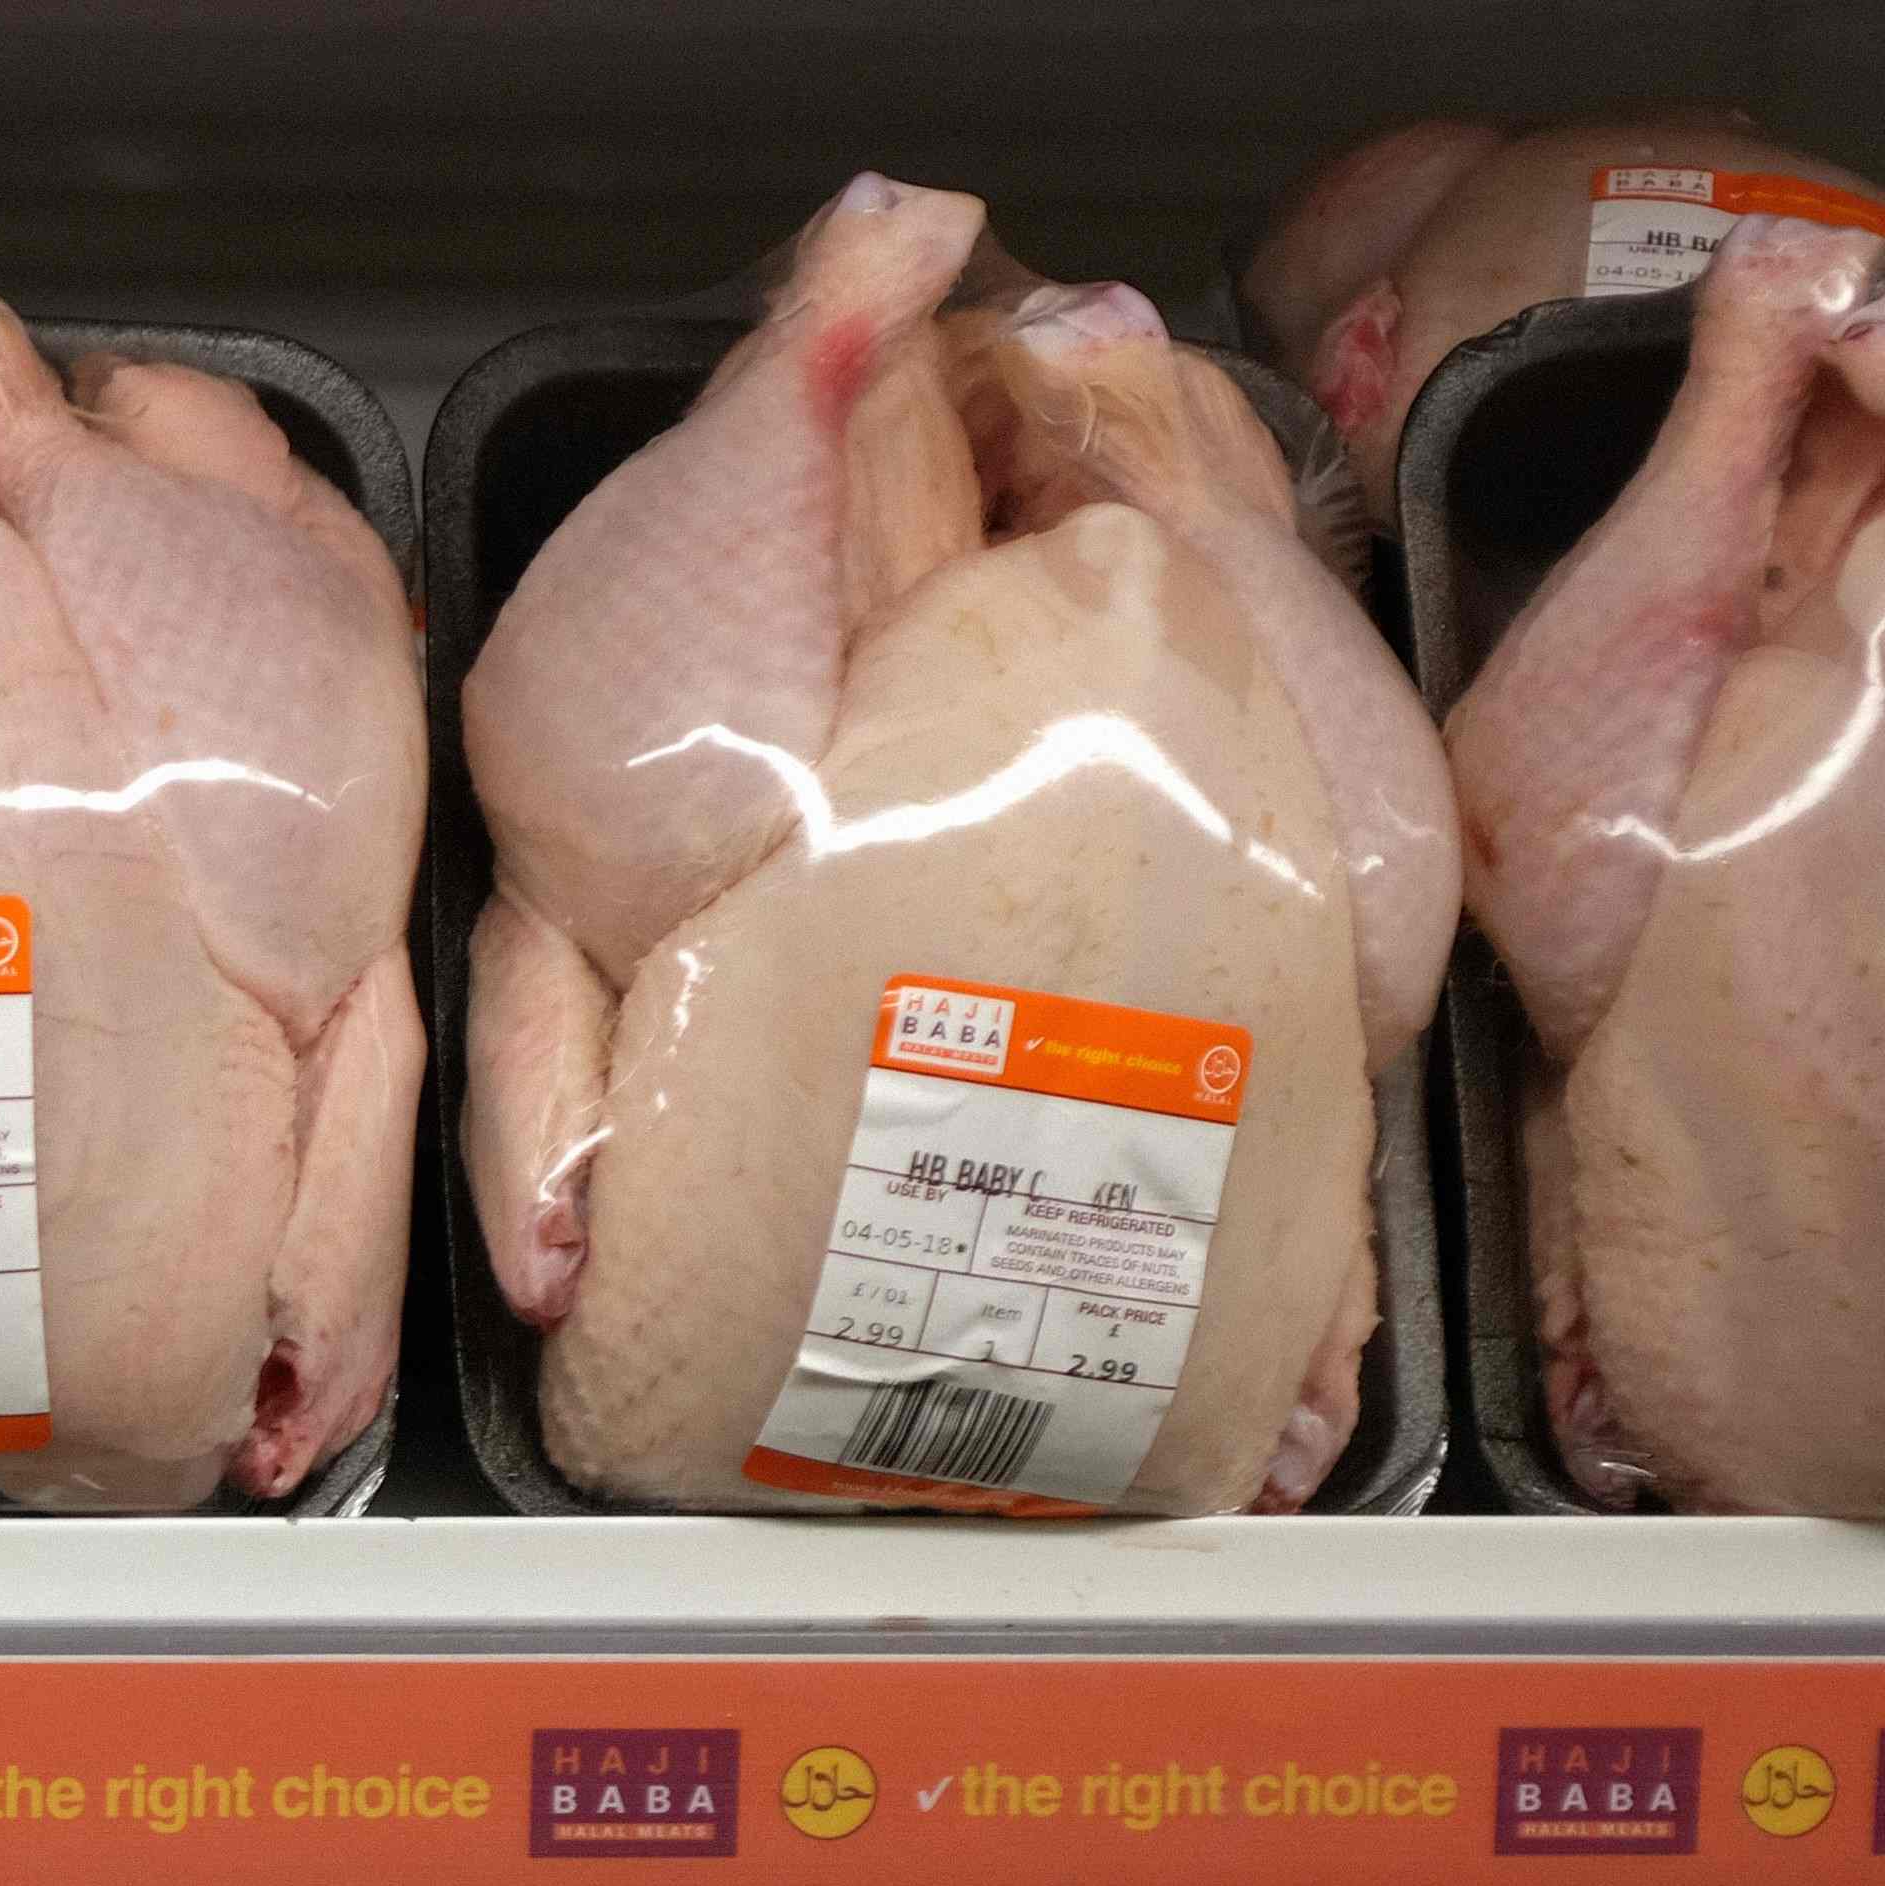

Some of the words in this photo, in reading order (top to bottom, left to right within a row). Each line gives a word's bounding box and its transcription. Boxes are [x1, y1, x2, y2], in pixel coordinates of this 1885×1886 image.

[1646, 230, 1681, 246] HB
[906, 993, 1003, 1018] HAJI
[903, 1016, 1001, 1049] BABA
[908, 1150, 947, 1186] HB
[957, 1158, 1023, 1195] BABY
[886, 1179, 922, 1199] USE
[925, 1185, 948, 1202] BY
[1068, 1209, 1175, 1236] REFRIGERATED
[1077, 1302, 1121, 1321] PACK
[1125, 1308, 1167, 1325] PRICE
[834, 1317, 904, 1345] 2.99
[1067, 1354, 1138, 1383] 2.99
[554, 1747, 708, 1776] HAJI
[1521, 1745, 1670, 1773] HAJI
[105, 1763, 253, 1834] right
[272, 1763, 491, 1819] choice
[552, 1786, 715, 1814] BABA
[962, 1763, 1063, 1819] the
[1079, 1761, 1224, 1831] right
[1245, 1762, 1457, 1818] choice
[1517, 1783, 1677, 1812] BABA
[557, 1825, 625, 1840] HALAL
[638, 1825, 710, 1839] MEATS
